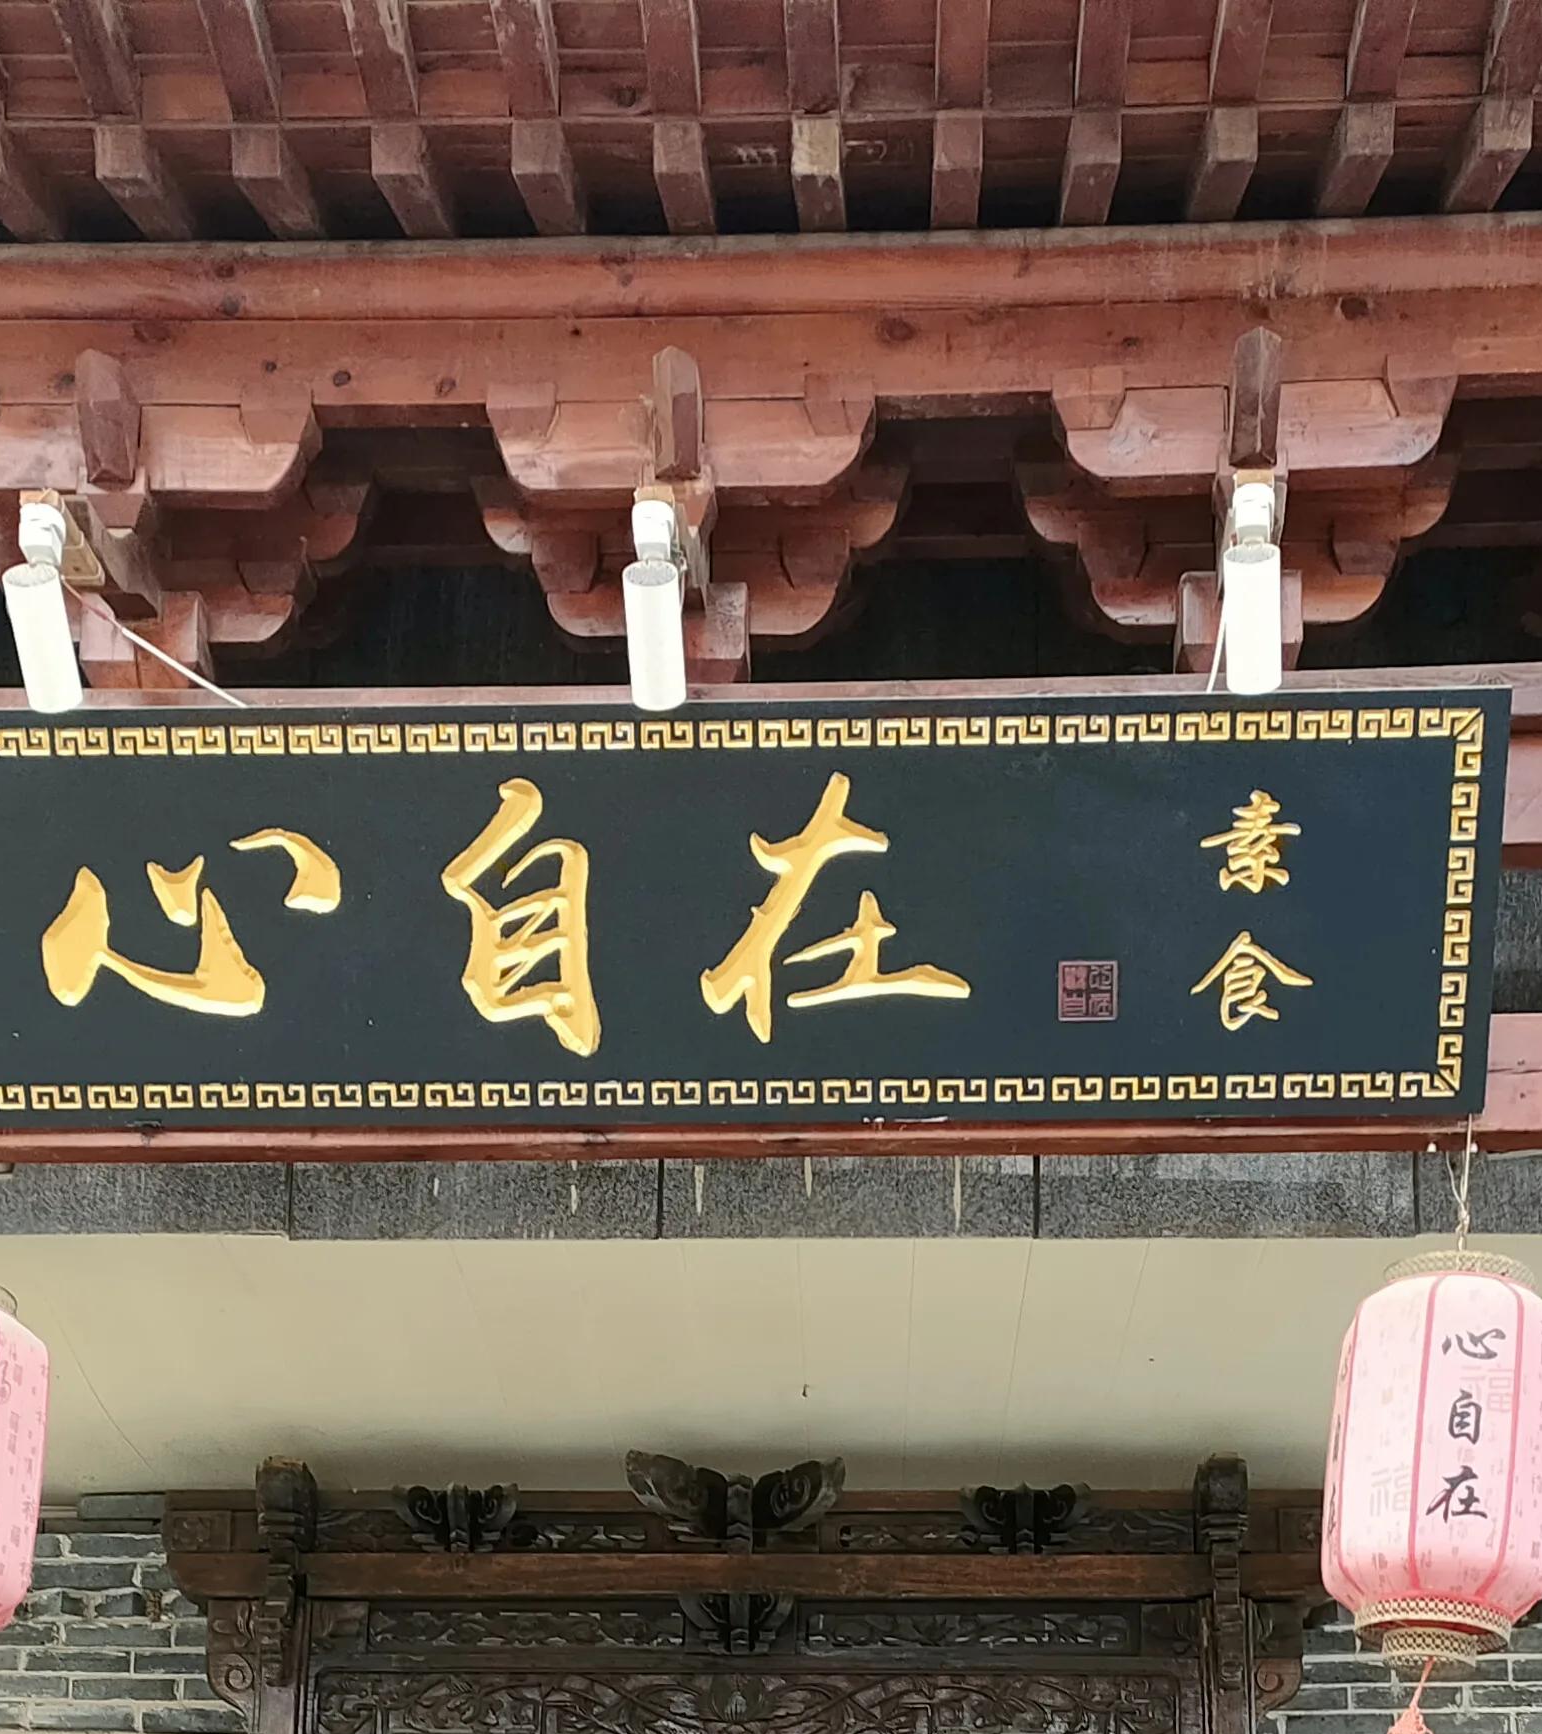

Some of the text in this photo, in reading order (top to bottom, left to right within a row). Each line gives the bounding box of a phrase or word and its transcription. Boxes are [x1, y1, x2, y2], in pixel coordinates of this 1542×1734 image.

[41, 771, 970, 1055] 心自在
[1193, 790, 1313, 1029] 素食
[1425, 1327, 1506, 1524] 心自在
